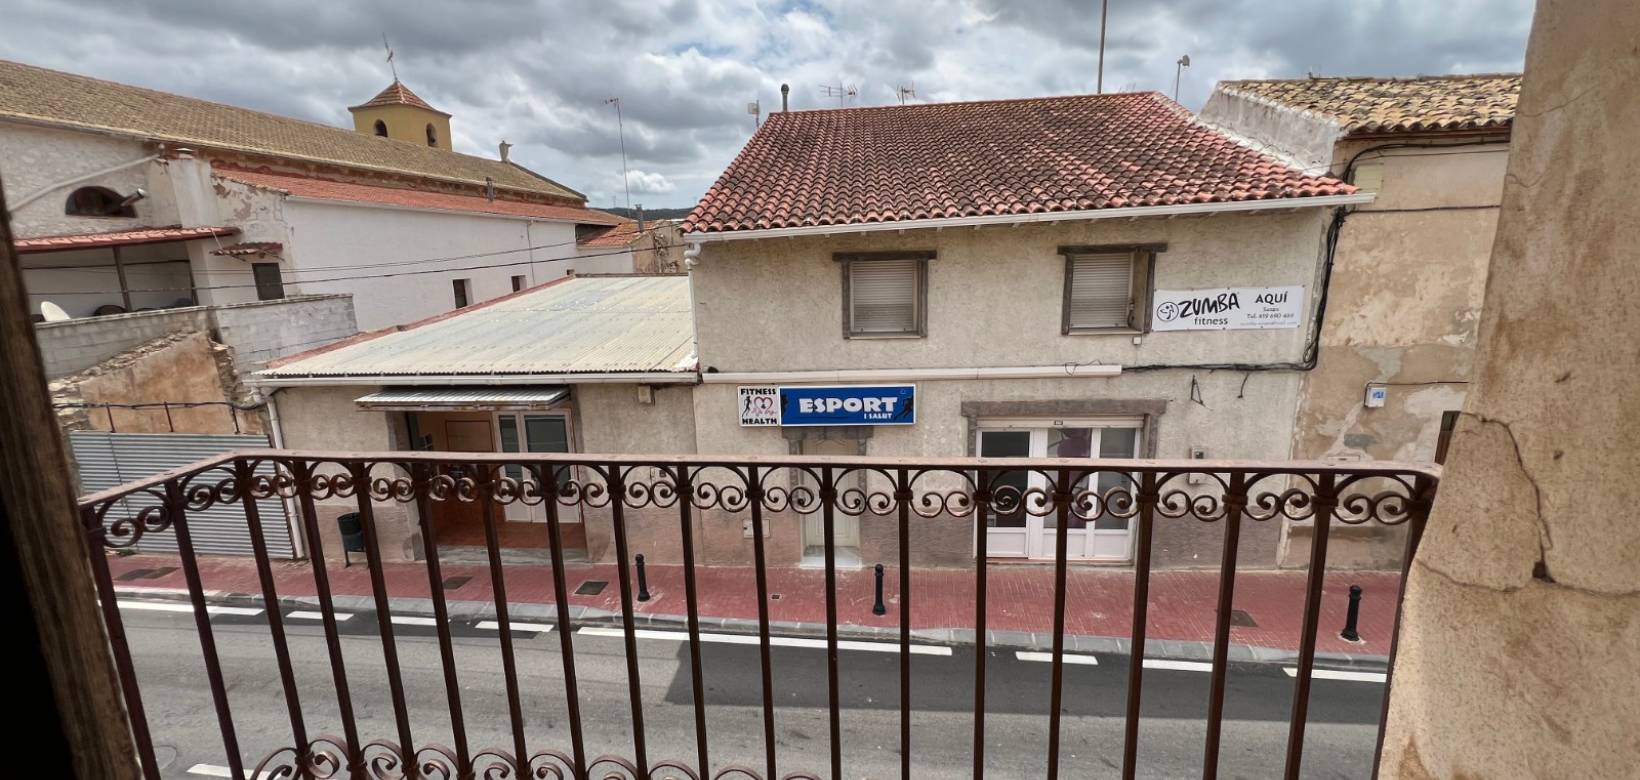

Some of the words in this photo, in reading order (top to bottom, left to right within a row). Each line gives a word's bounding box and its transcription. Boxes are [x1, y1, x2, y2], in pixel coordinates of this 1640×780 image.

[1178, 293, 1240, 318] ZUMBA
[1255, 291, 1288, 305] AQUÍ
[1194, 317, 1228, 325] fitness
[799, 397, 898, 413] ESPORT
